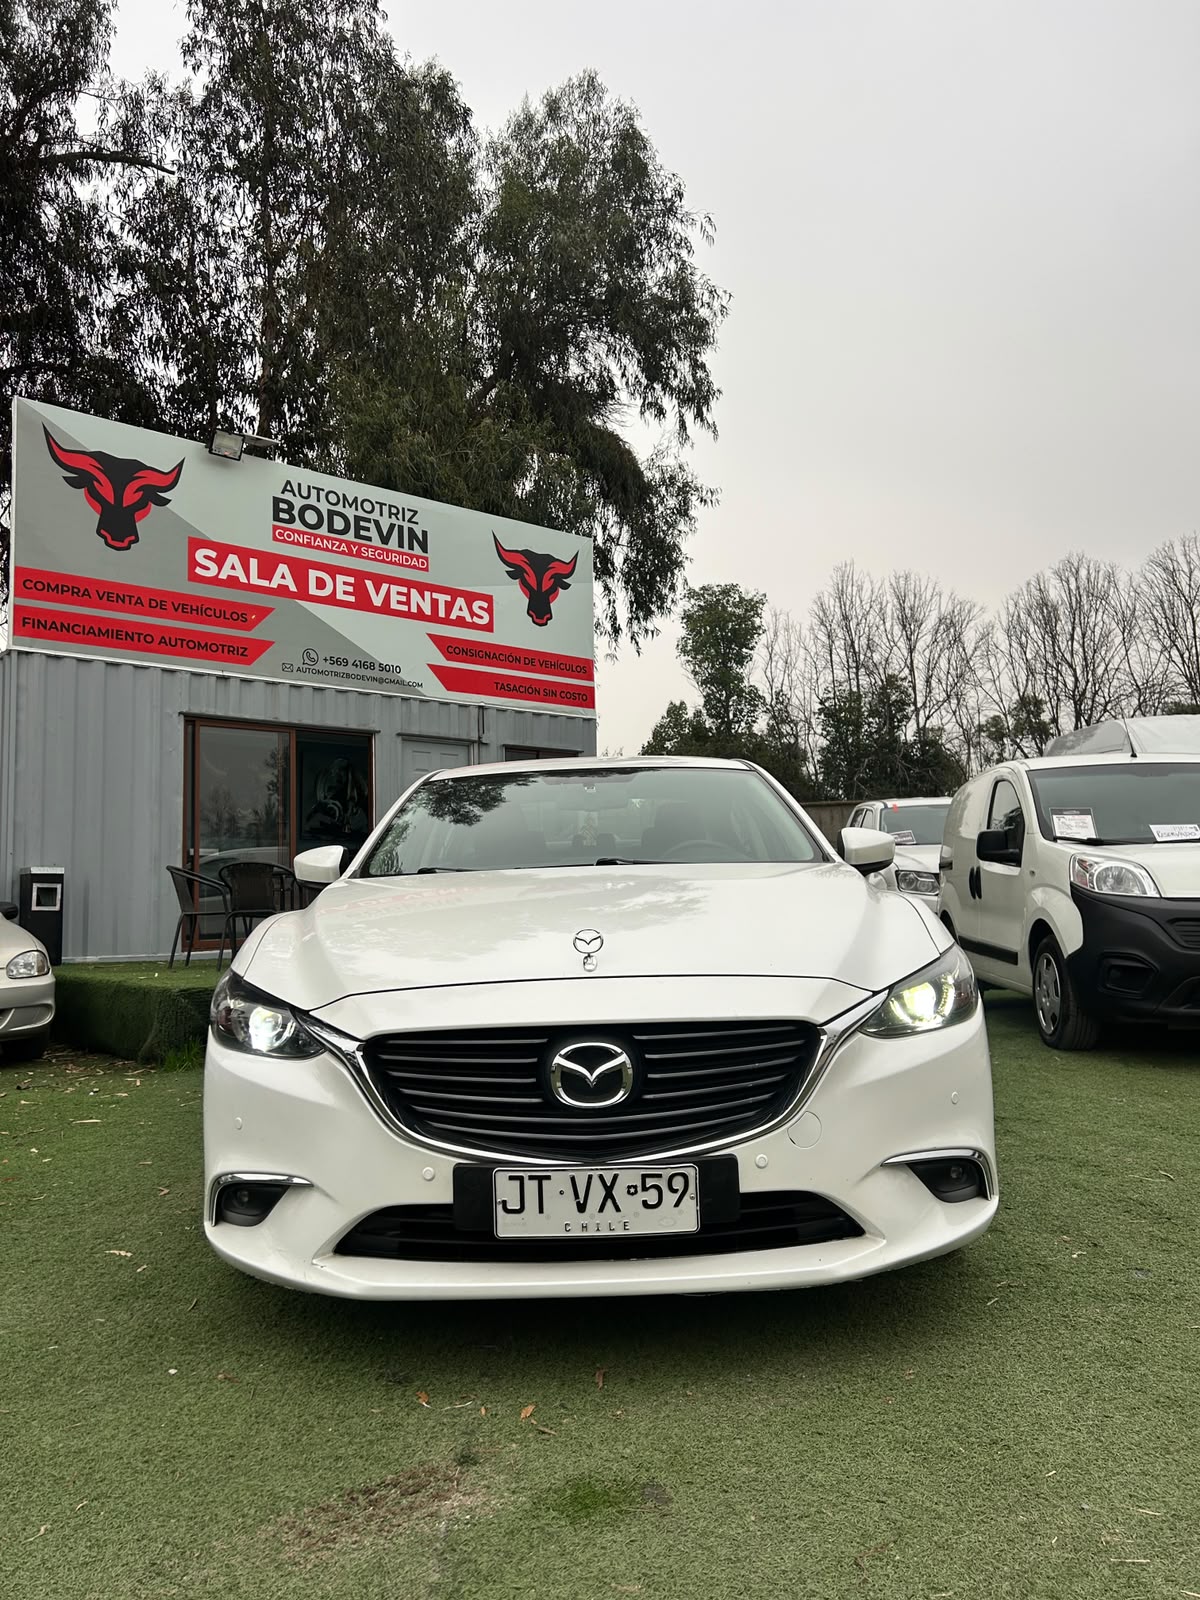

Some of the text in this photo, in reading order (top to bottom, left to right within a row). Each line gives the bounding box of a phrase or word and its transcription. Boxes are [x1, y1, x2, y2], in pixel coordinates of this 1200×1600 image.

[281, 480, 419, 525] AUTOMOTRIZ
[273, 496, 428, 554] BODEVIN
[275, 530, 427, 568] CONFIANZA Y SEGURIDAD
[23, 579, 248, 623] COMPRA VENTA DE VEHÍCULOS
[194, 548, 489, 625] SALA DE VENTAS
[22, 617, 248, 657] FINANCIAMIENTO AUTOMOTRIZ
[296, 666, 423, 688] AUTOMOTRIZBODEVIN@GMAIL.COM
[323, 656, 401, 673] +569 4168 5010
[447, 645, 587, 674] CONSIGNACIÓN DE VEHÍCULOS
[494, 682, 588, 702] TASACIÓN SIN COSTO
[564, 1220, 630, 1232] CHILE
